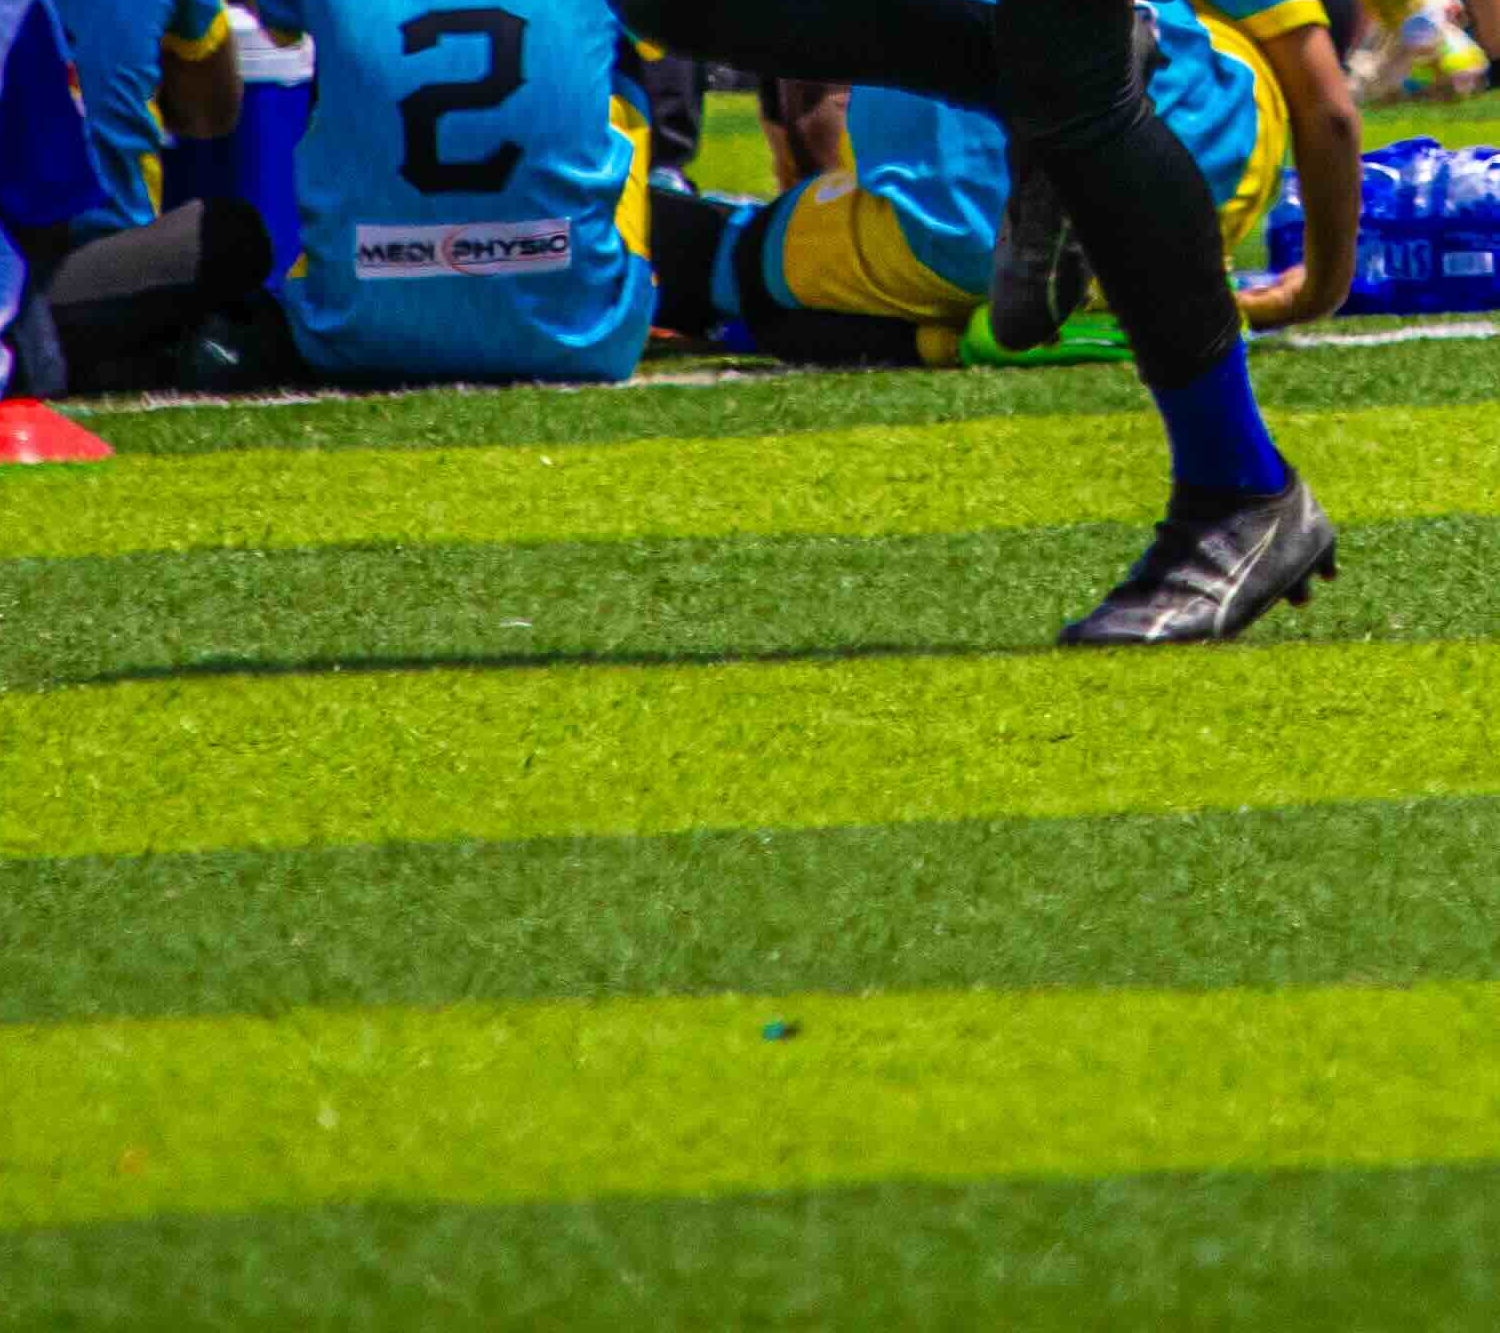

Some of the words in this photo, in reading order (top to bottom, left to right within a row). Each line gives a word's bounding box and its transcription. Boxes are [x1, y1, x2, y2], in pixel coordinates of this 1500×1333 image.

[396, 6, 529, 198] 2
[359, 240, 436, 264] MEDI
[451, 233, 568, 261] PHYSIO
